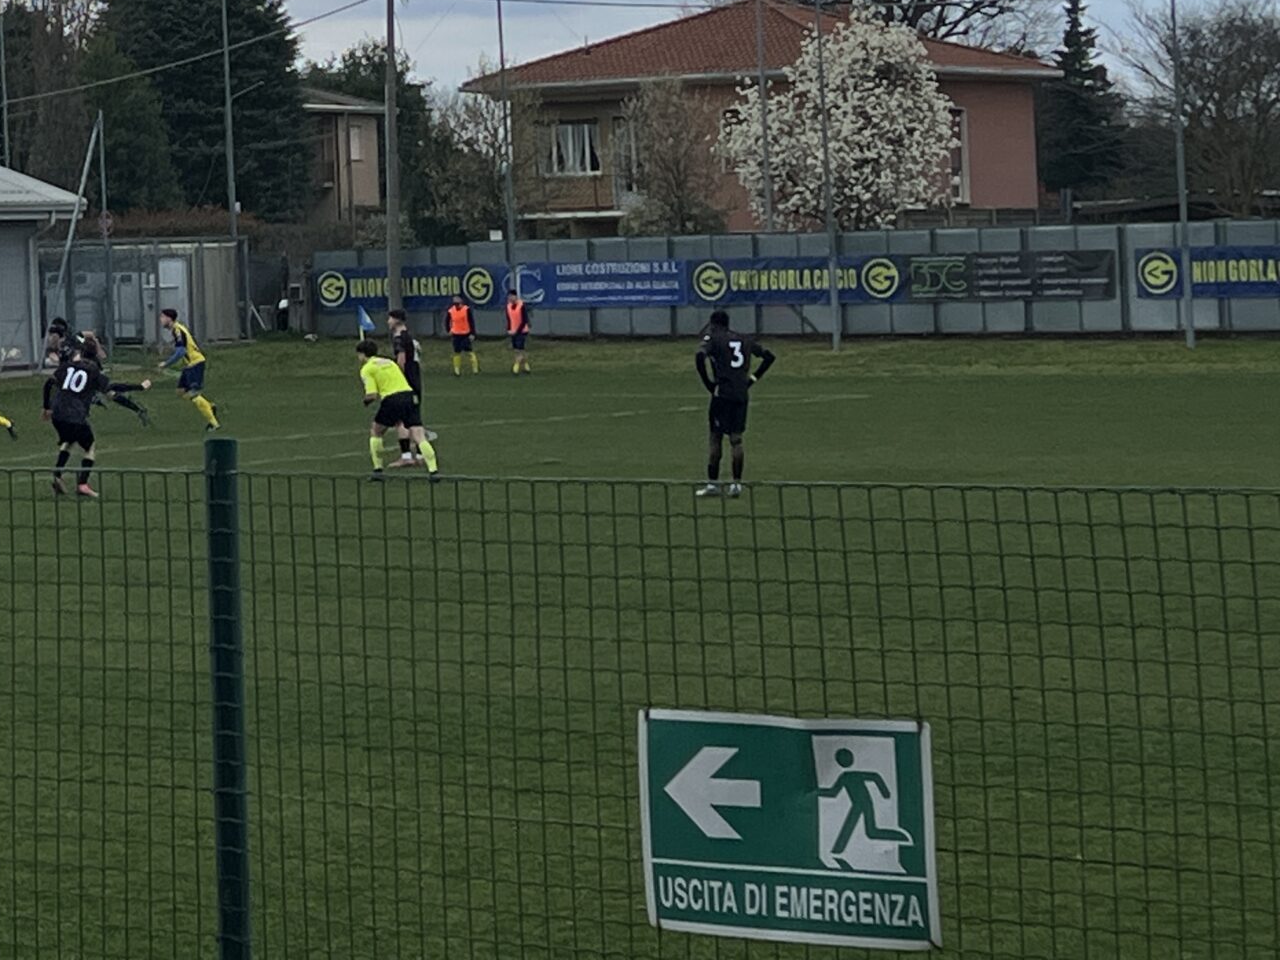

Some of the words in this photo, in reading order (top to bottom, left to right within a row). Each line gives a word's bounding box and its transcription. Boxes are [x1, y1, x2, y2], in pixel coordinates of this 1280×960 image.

[813, 268, 857, 290] CACIO
[1191, 260, 1226, 283] NION
[728, 341, 744, 368] 3
[62, 366, 88, 393] 10
[658, 876, 738, 914] USCITA
[745, 882, 768, 916] DI
[774, 885, 925, 928] EMERGENZA
